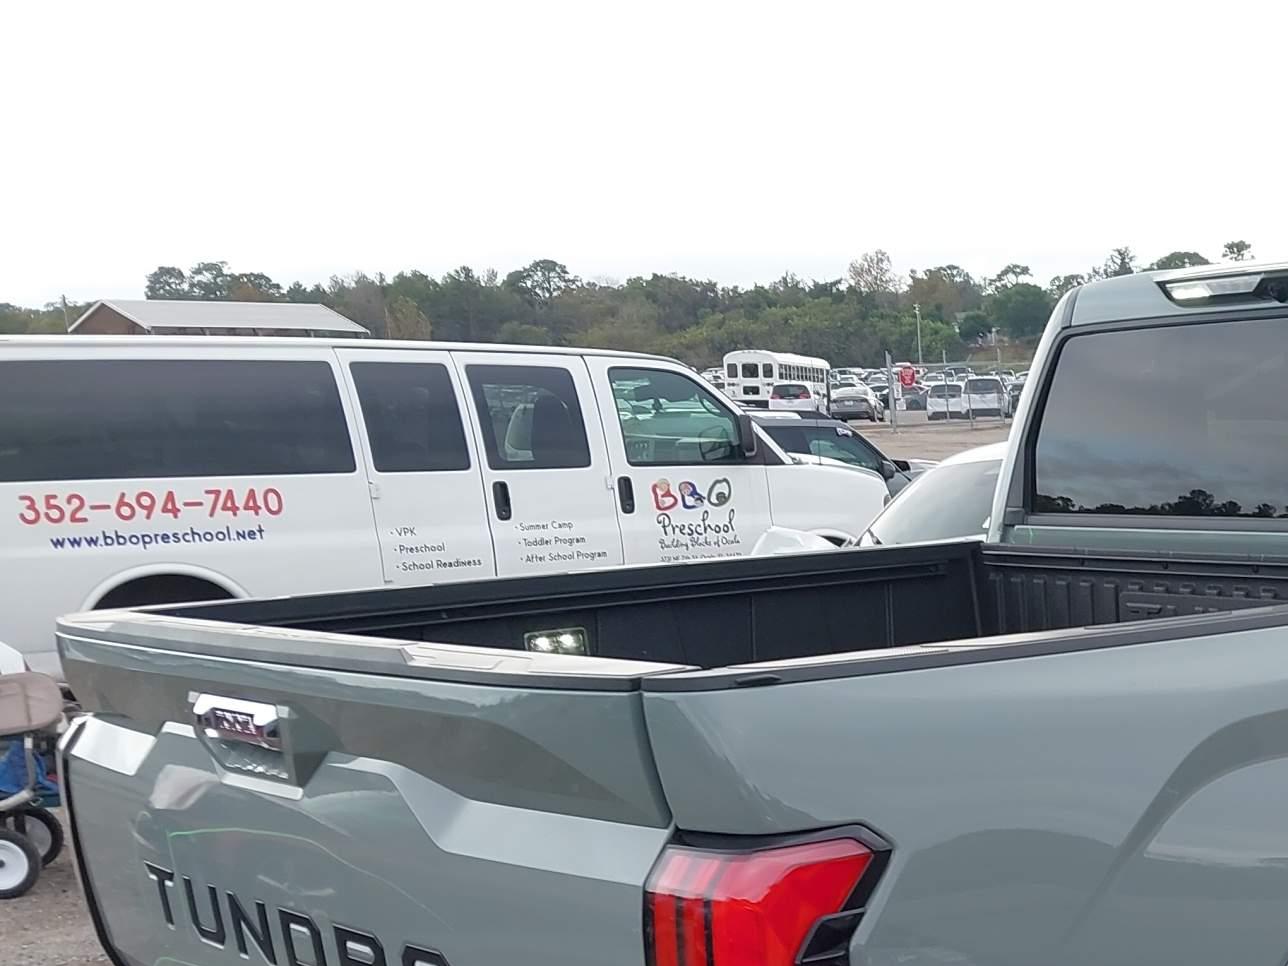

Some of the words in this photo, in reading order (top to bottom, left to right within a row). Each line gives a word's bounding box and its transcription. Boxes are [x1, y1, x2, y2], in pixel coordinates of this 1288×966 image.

[18, 488, 283, 525] 352-694-7440
[520, 522, 549, 531] Summer
[551, 521, 574, 530] Camp
[656, 509, 735, 536] Preschool
[395, 527, 417, 537] VPK
[523, 537, 552, 547] Toddler
[554, 536, 586, 546] Program
[398, 542, 446, 554] Preschool
[525, 553, 546, 563] After
[549, 552, 575, 562] School
[577, 550, 608, 560] Program
[402, 560, 434, 571] School
[436, 558, 482, 569] Readiness
